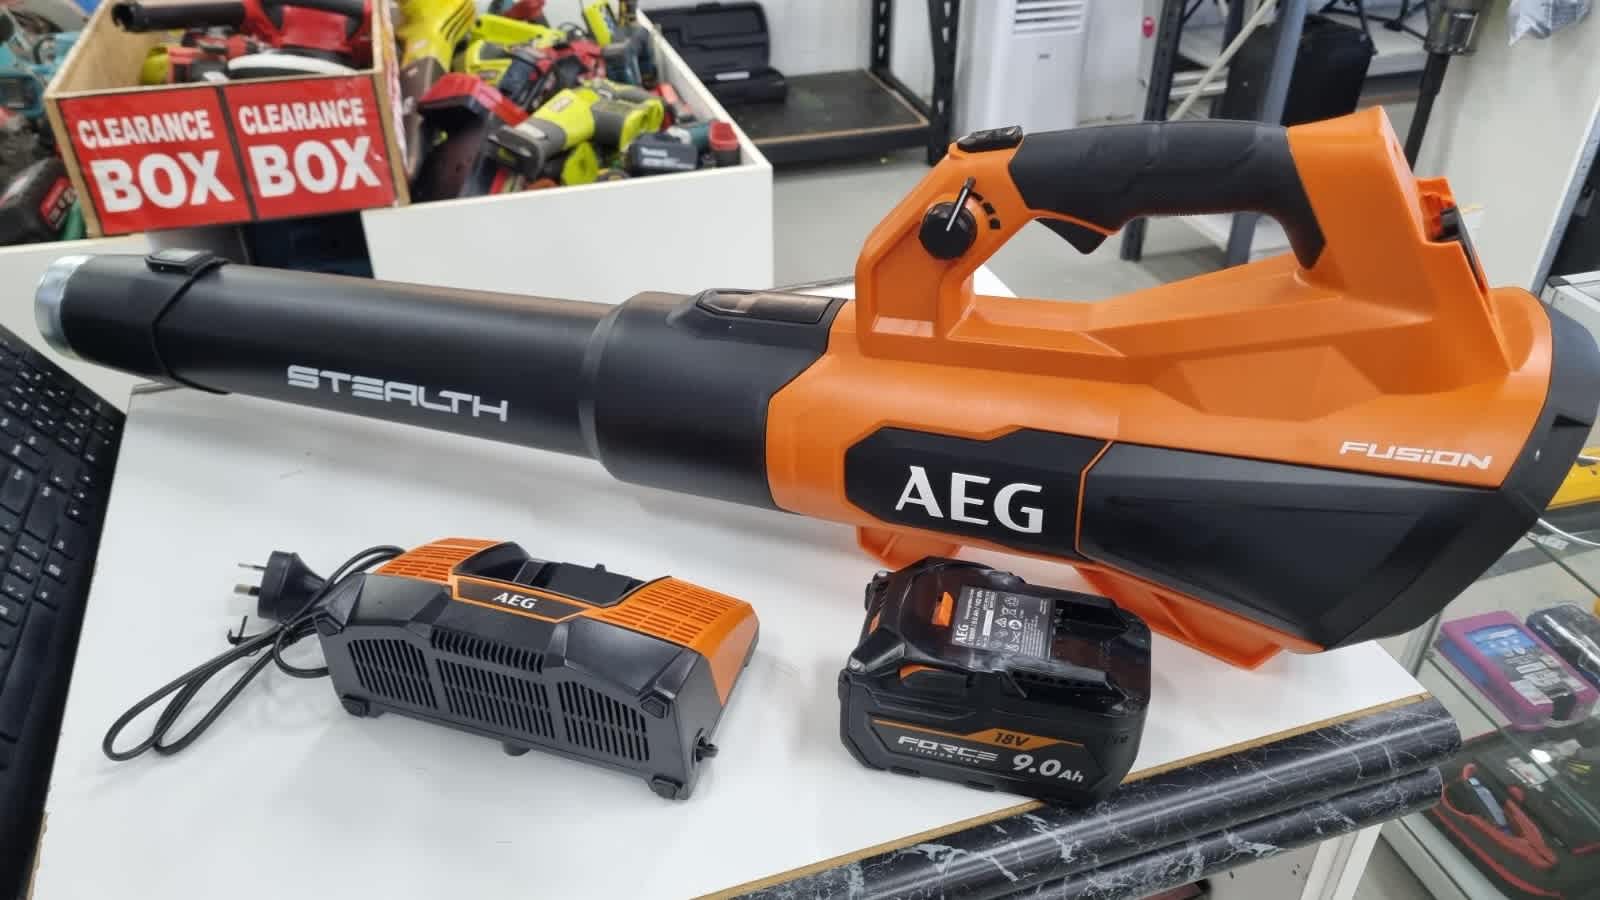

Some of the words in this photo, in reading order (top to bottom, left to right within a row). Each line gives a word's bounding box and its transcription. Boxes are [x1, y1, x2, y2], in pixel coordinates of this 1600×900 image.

[77, 109, 214, 149] CLEARANCE
[238, 98, 367, 135] CLEARANCE
[90, 149, 235, 213] BOX
[248, 136, 382, 198] BOX
[287, 364, 509, 422] STEALTH
[895, 465, 1044, 534] AEG
[493, 592, 537, 609] AEG
[955, 623, 969, 644] AEG
[898, 735, 999, 762] FORCE
[994, 731, 1031, 746] 18V
